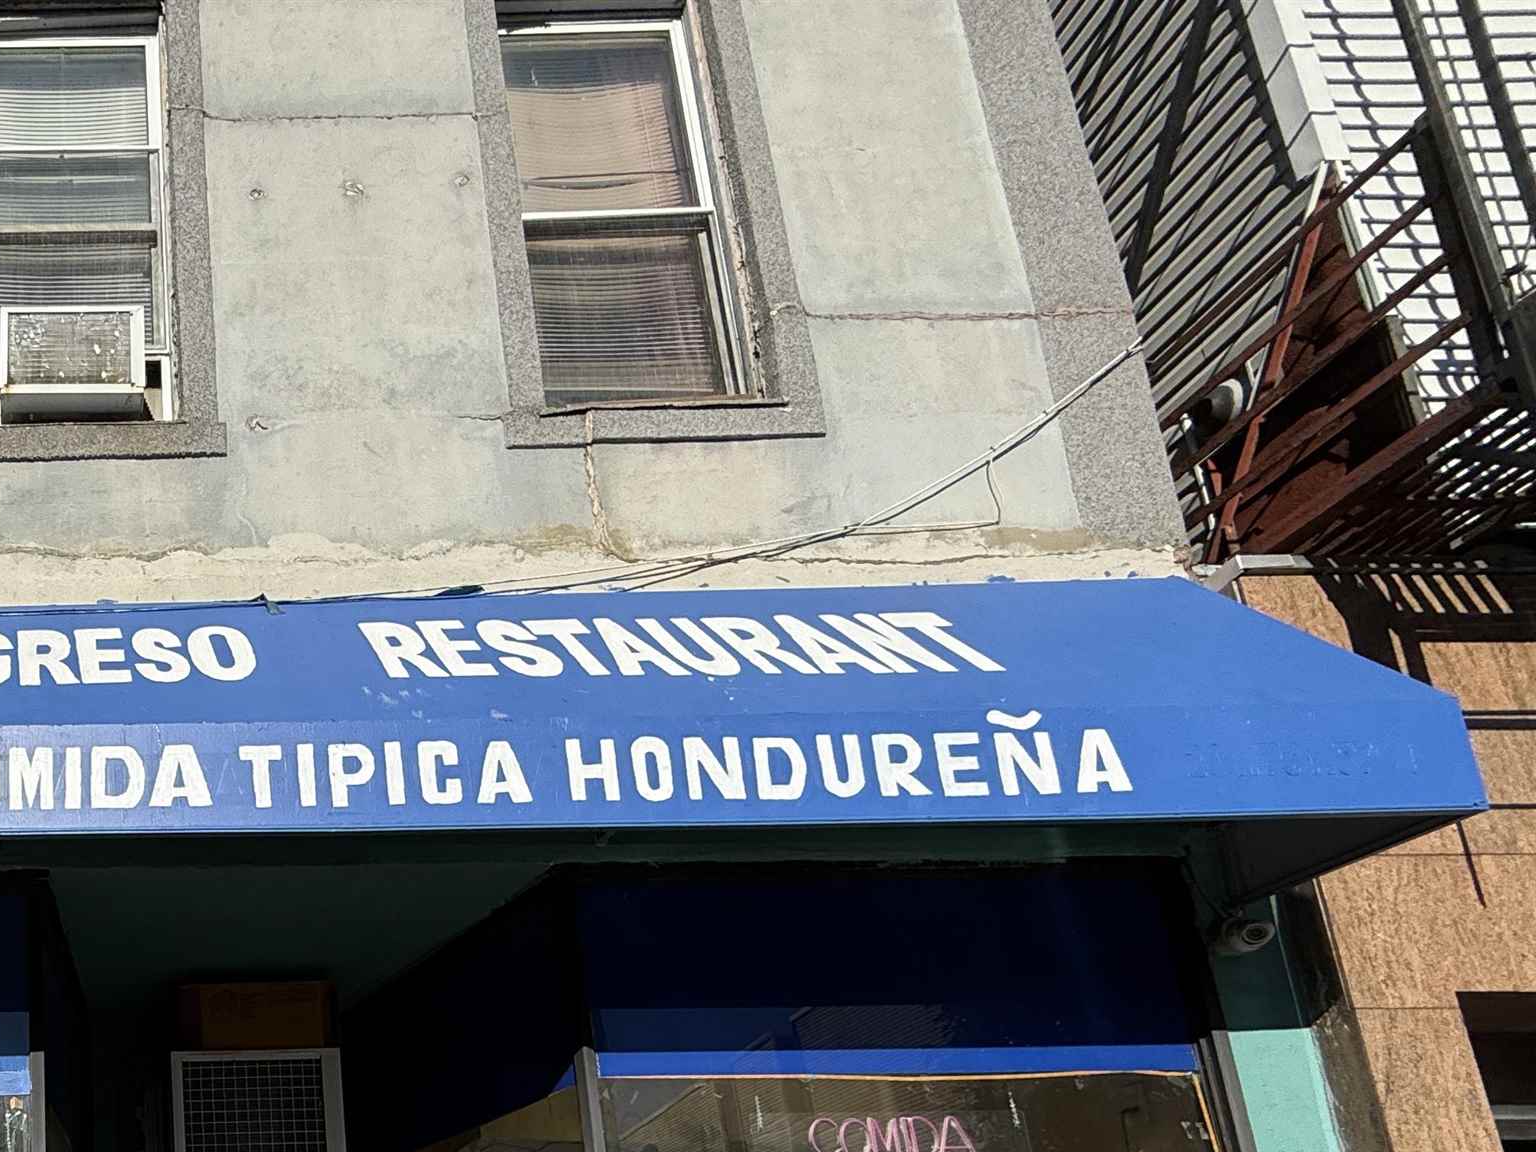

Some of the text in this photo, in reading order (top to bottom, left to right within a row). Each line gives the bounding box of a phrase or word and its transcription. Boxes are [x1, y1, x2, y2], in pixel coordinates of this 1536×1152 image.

[357, 611, 1005, 678] RESTAURANT
[239, 738, 533, 808] TIPICA
[566, 708, 1132, 802] HONDUREÑA
